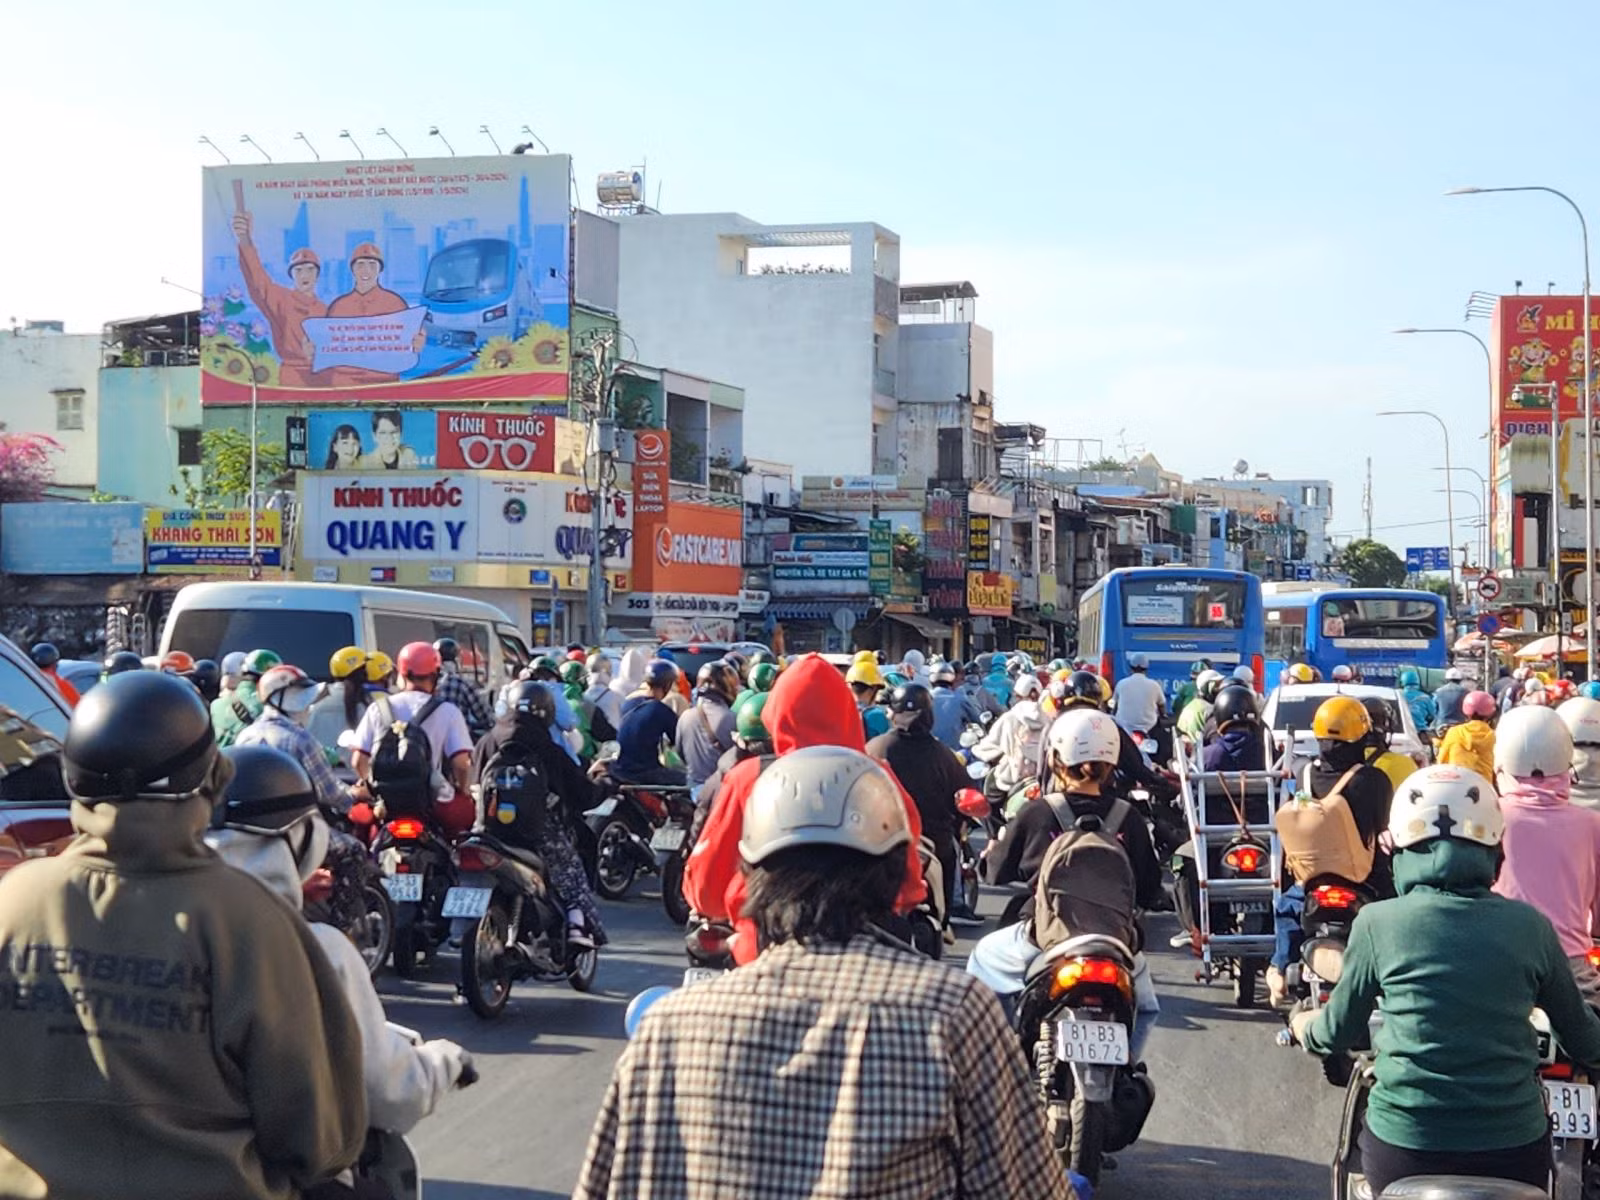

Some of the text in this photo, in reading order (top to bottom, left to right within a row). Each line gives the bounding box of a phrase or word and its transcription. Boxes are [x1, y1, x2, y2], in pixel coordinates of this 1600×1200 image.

[448, 413, 545, 436] KÍNH THUỐC
[334, 477, 463, 508] KÍNH THUỐC
[152, 527, 202, 543] KHANG
[208, 521, 239, 543] THÁI
[327, 520, 467, 556] QUANG Y
[627, 599, 650, 609] 303
[1071, 1024, 1116, 1042] 81-B3
